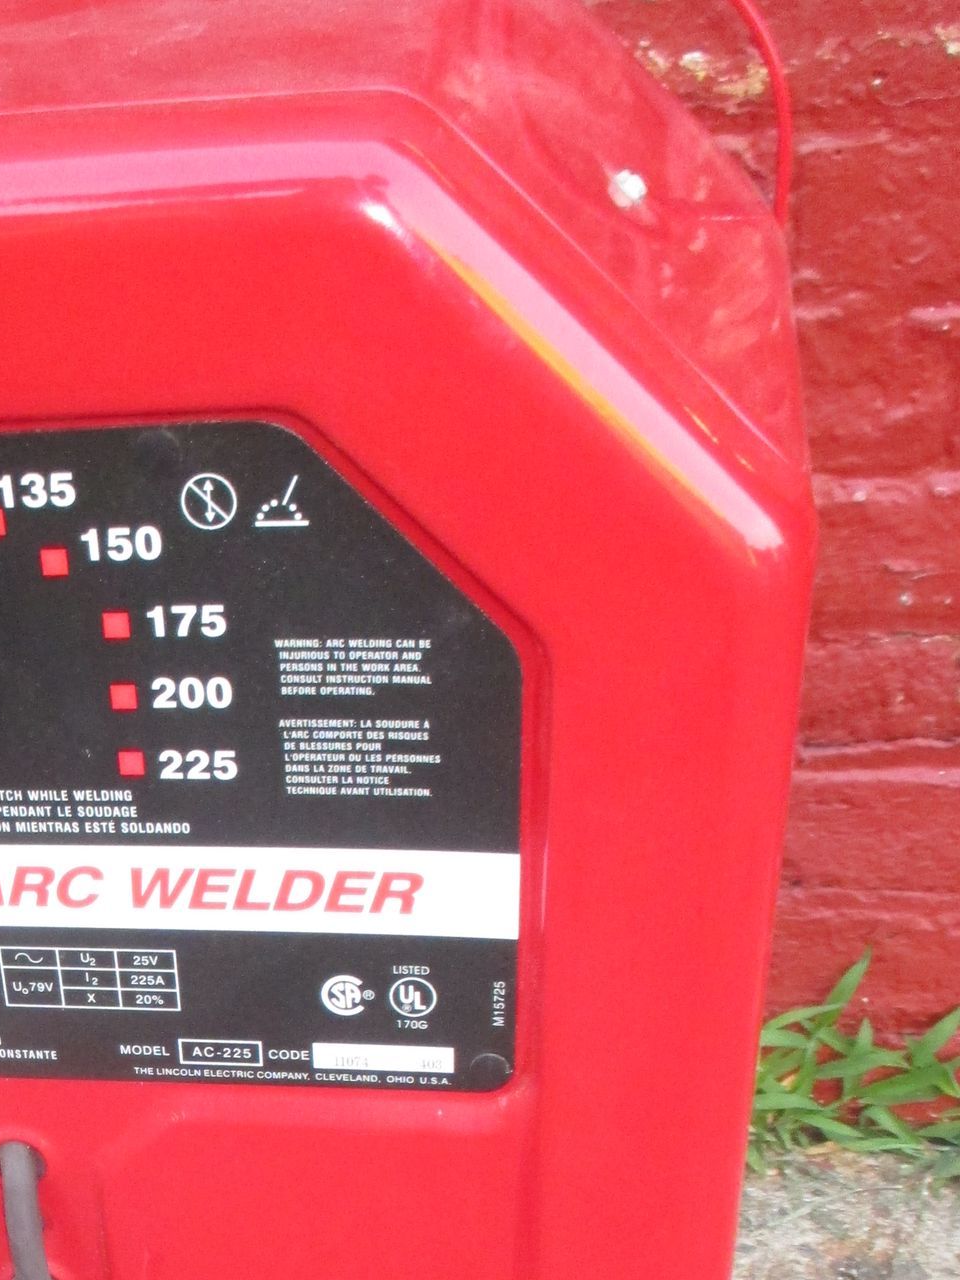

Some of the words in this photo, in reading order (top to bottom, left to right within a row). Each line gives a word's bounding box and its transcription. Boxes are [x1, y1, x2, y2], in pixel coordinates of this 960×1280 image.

[81, 526, 162, 561] 150
[147, 605, 226, 637] 175
[275, 639, 323, 647] WARNING:
[326, 639, 345, 648] ARC
[349, 639, 392, 648] WELDING
[396, 639, 415, 648] CAN
[419, 640, 431, 648] BE
[280, 651, 329, 659] INJURIOUS
[334, 651, 345, 659] TO
[349, 651, 398, 660] OPERATOR
[402, 652, 422, 660] AND
[280, 663, 323, 671] PERSONS
[327, 663, 336, 671] IN
[341, 663, 358, 671] THE
[362, 663, 390, 672] WORK
[393, 664, 422, 672] AREA.
[281, 675, 322, 683] CONSULT
[326, 675, 388, 683] INSTRUCTION
[392, 676, 432, 684] MANUAL
[152, 677, 232, 709] 200
[281, 686, 316, 695] BEFORE
[320, 687, 376, 695] OPERATING.
[279, 719, 357, 727] AVERTISSEMENT:
[360, 720, 372, 728] LA
[376, 720, 419, 728] SOUDURE
[284, 731, 309, 739] L'ARC
[313, 731, 362, 739] COMPORTE
[367, 731, 384, 739] DES
[388, 732, 429, 740] RISQUES
[284, 742, 296, 750] DE
[300, 742, 352, 750] BLESSURES
[356, 743, 381, 751] POUR
[349, 754, 361, 762] OU
[365, 754, 382, 762] LES
[386, 754, 440, 763] PERSONNES
[159, 750, 238, 780] 225
[285, 764, 310, 772] DANS
[328, 765, 351, 773] ZONE
[355, 765, 367, 773] DE
[370, 765, 413, 773] TRAVAIL.
[286, 775, 338, 784] CONSULTER
[342, 776, 353, 784] LA
[357, 776, 389, 784] NOTICE
[27, 790, 68, 801] WHILE
[73, 790, 132, 801] WELDING
[286, 786, 336, 795] TECHNIQUE
[340, 787, 369, 795] AVANT
[374, 788, 433, 796] UTILISATION.
[57, 806, 72, 817] LE
[77, 806, 137, 817] SOUDAGE
[16, 822, 79, 833] MIENTRAS
[85, 820, 115, 833] ESTÉ
[121, 822, 190, 833] SOLDANDO
[131, 868, 423, 914] WELDER
[133, 956, 158, 965] 25V
[393, 966, 430, 975] LISTED
[131, 975, 164, 985] 225A
[88, 993, 96, 1002] X
[136, 995, 163, 1004] 20%
[492, 982, 505, 1026] M15725
[397, 1020, 428, 1029] 170G
[120, 1045, 170, 1056] MODEL
[193, 1047, 251, 1058] AC-225
[269, 1050, 309, 1060] CODE
[134, 1067, 154, 1075] THE
[157, 1068, 201, 1076] LINCOLN
[204, 1069, 254, 1078] ELECTRIC
